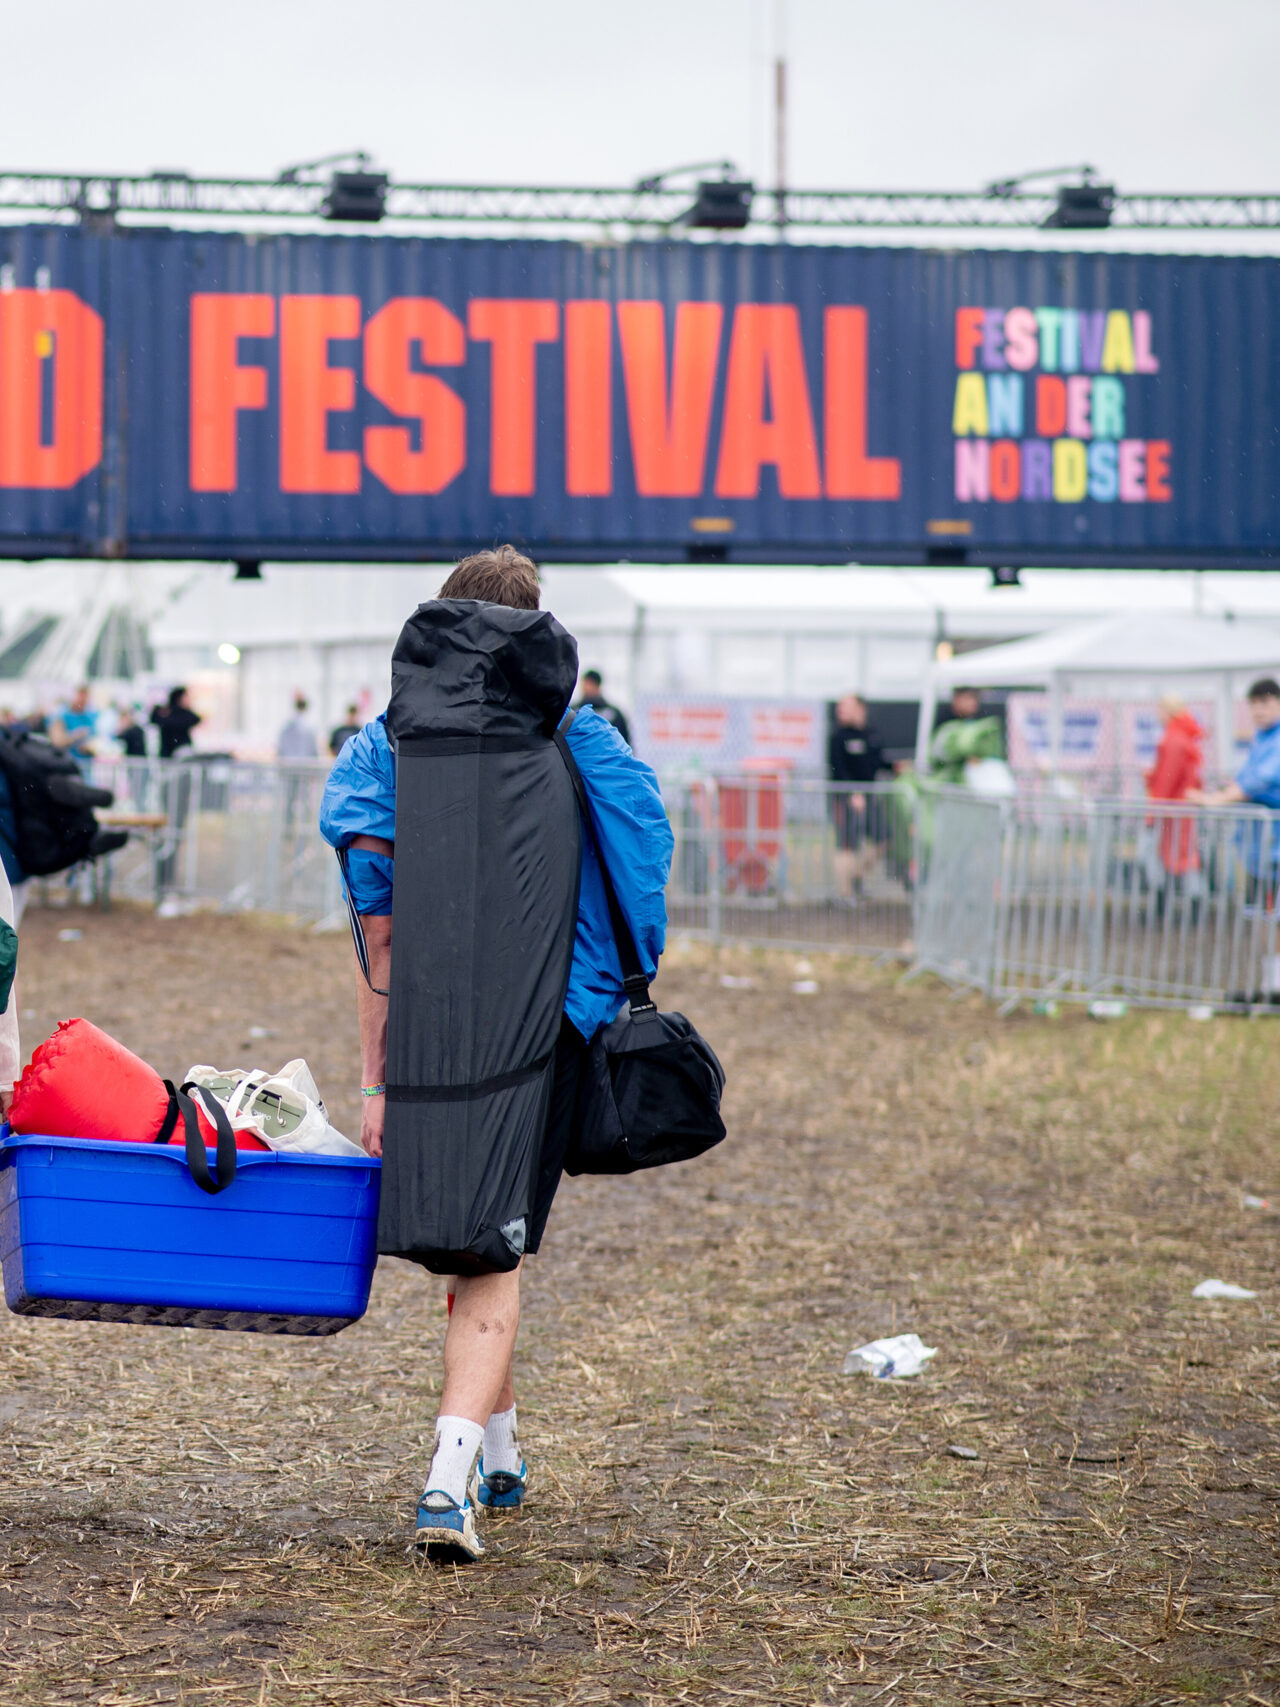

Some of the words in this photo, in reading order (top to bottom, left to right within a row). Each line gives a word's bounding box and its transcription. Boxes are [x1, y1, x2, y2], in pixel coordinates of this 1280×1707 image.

[955, 306, 1159, 374] FESTIVAL
[190, 293, 902, 500] FESTIVAL
[952, 371, 1024, 438] AN
[1035, 373, 1126, 440] DER
[954, 437, 1173, 503] NORDSEE
